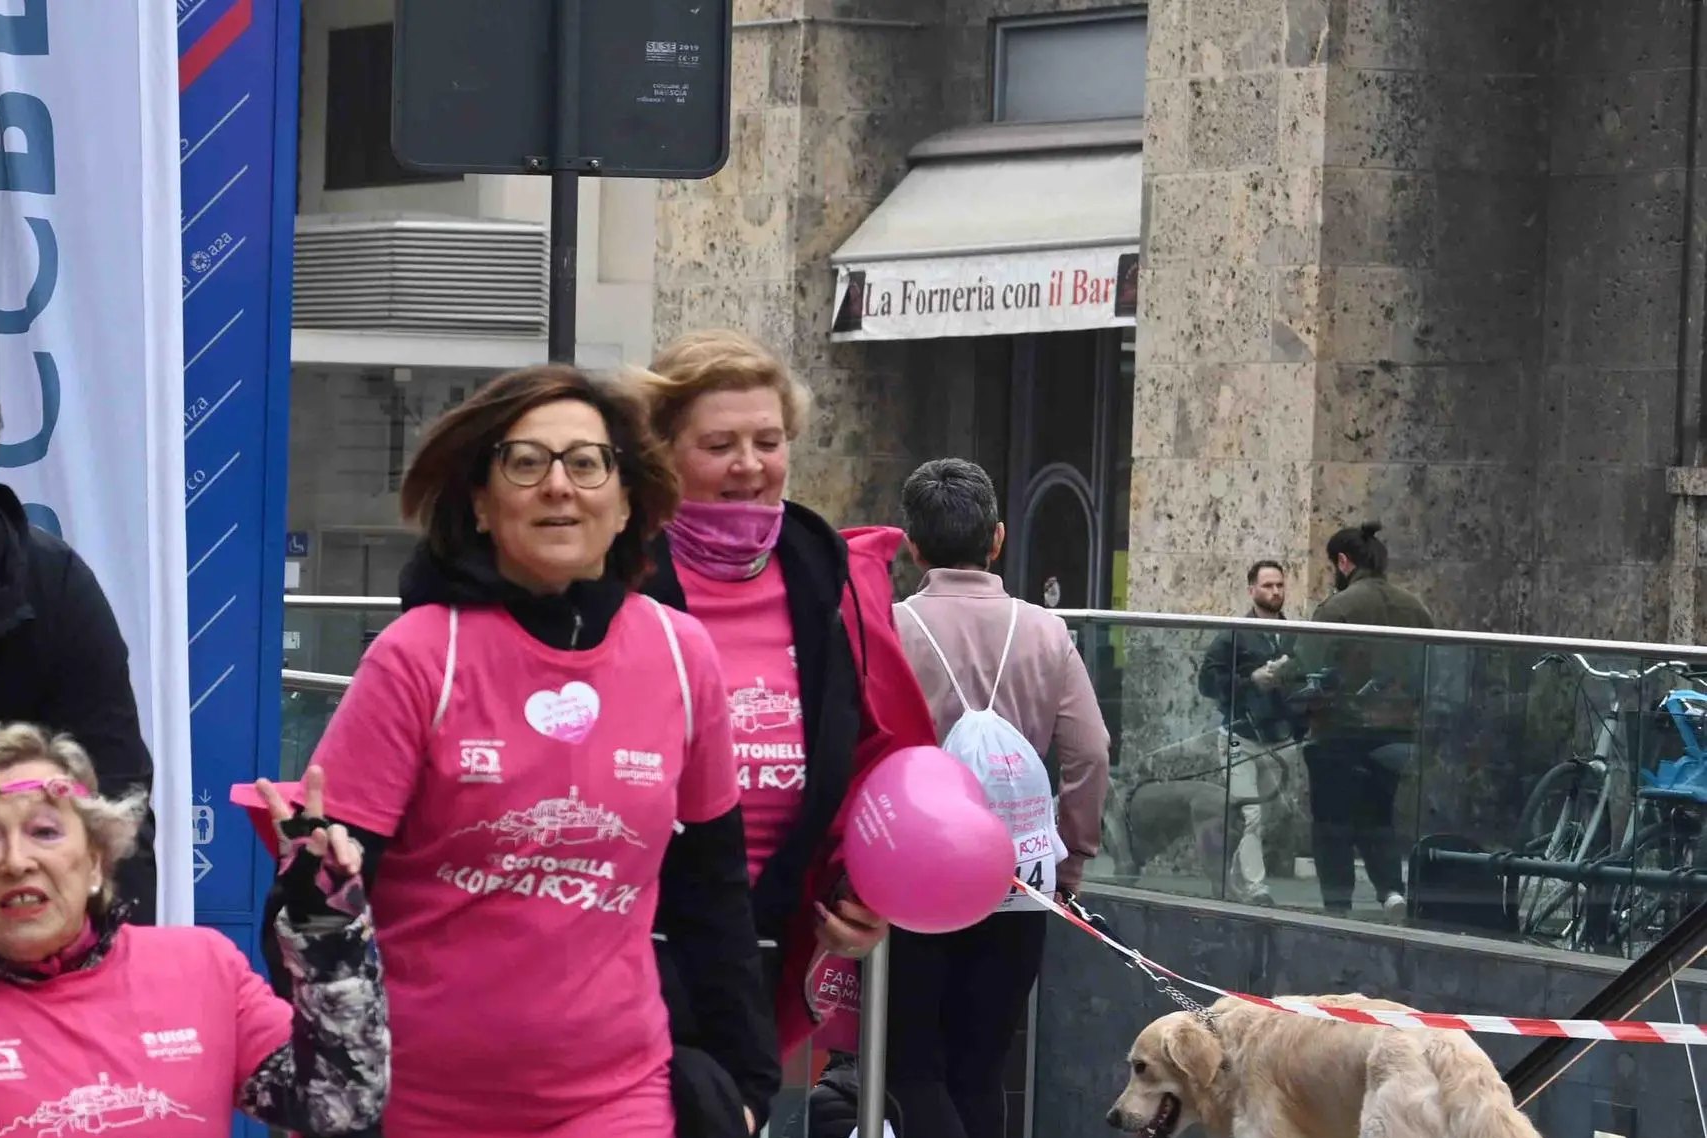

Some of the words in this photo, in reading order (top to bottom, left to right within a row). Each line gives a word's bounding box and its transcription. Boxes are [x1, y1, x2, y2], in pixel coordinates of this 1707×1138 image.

[207, 232, 233, 258] a2a
[864, 282, 891, 317] La
[900, 276, 995, 315] Forneria
[1001, 281, 1041, 309] con
[1048, 270, 1064, 307] il
[1072, 268, 1115, 306] Bar
